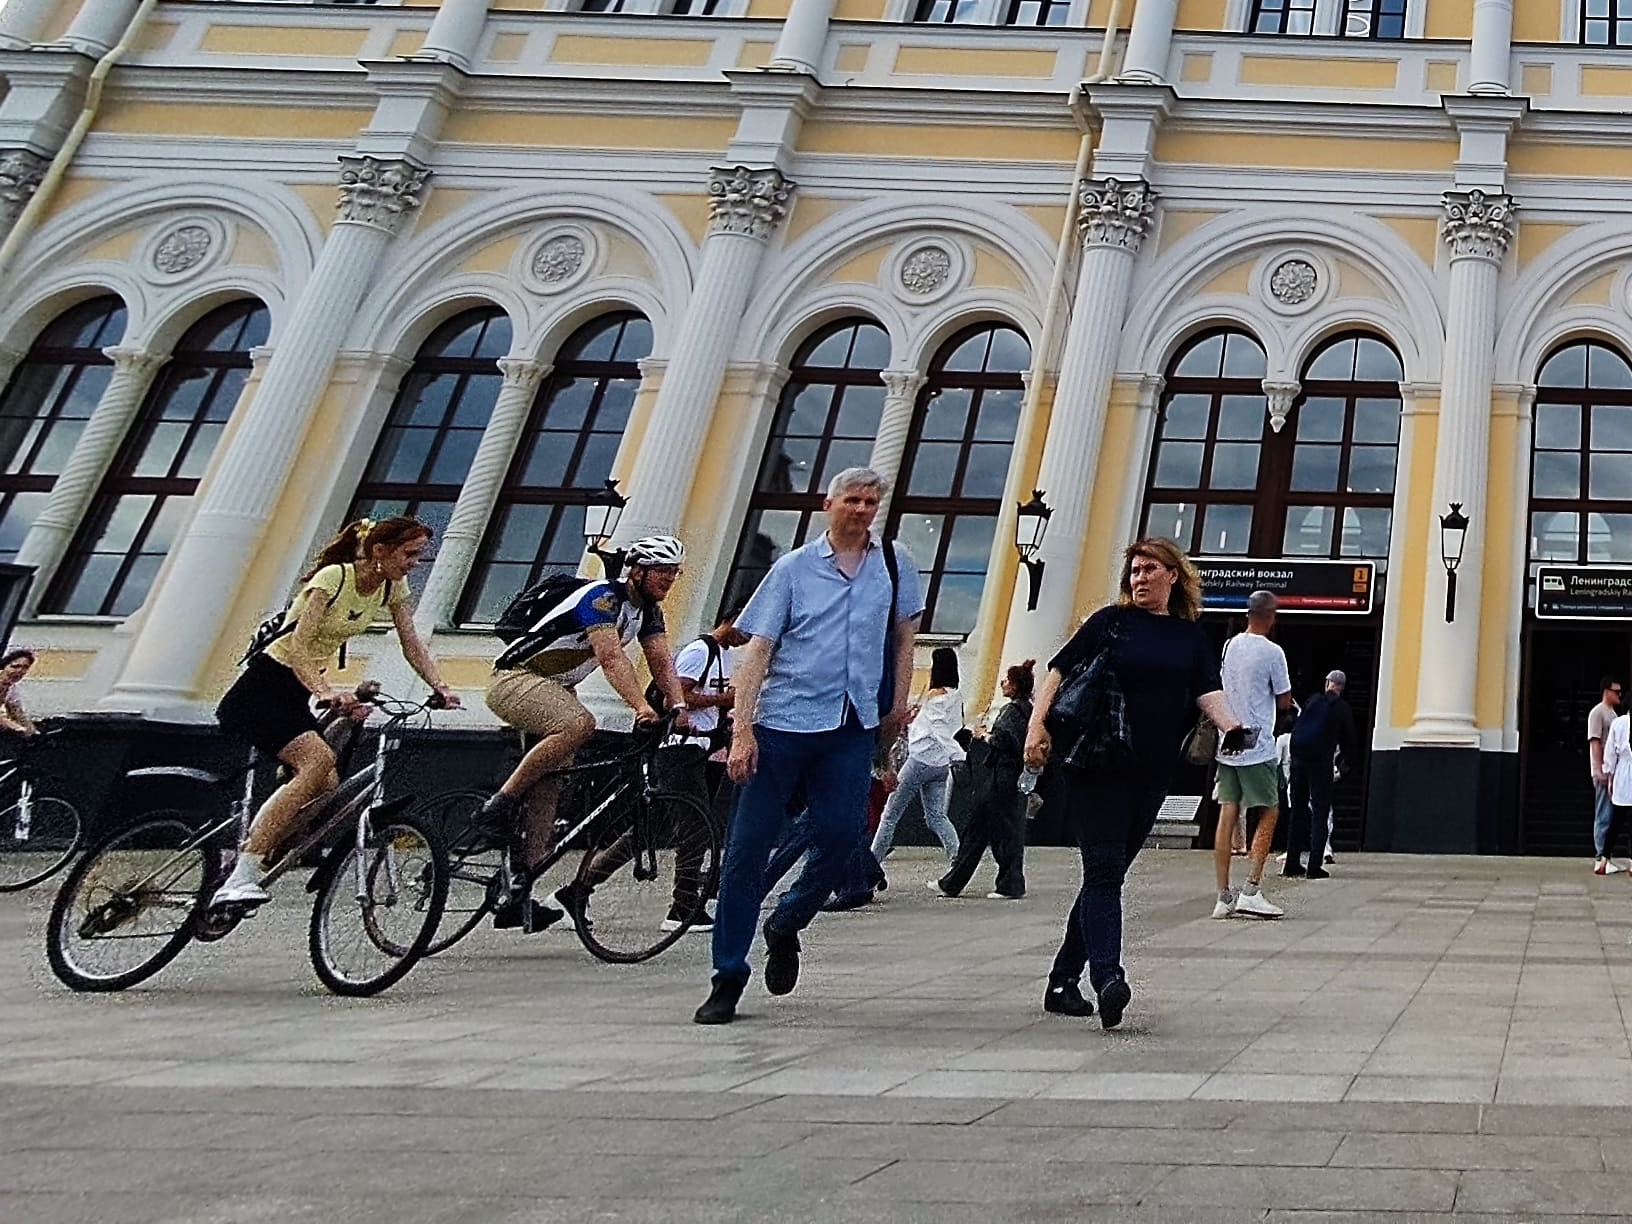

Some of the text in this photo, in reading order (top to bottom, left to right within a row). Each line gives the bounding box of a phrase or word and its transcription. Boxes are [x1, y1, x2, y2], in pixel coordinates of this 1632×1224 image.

[1257, 570, 1294, 579] вокзал
[1225, 580, 1253, 589] Railway
[1255, 580, 1288, 588] Terminal
[1570, 588, 1622, 597] Leningradskiy
